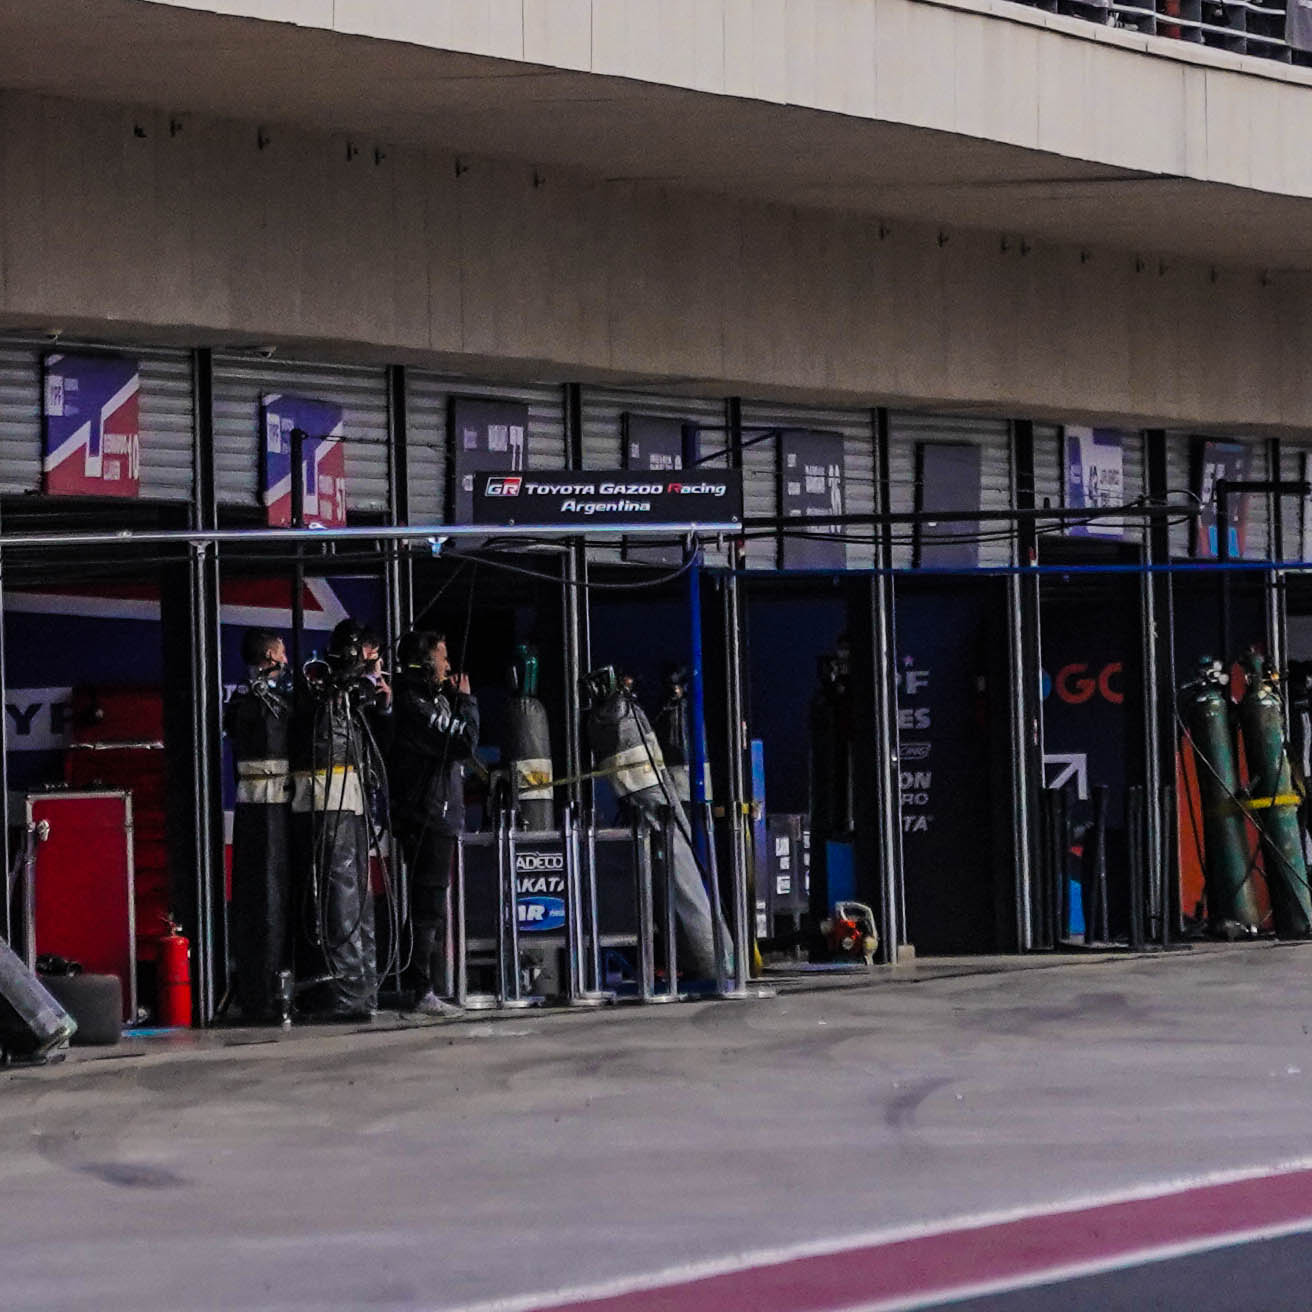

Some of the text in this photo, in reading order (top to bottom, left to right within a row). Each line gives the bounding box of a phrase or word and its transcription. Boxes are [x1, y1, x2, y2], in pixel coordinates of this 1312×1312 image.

[486, 481, 727, 497] GR TOYOTA GAZOO Racing
[560, 499, 651, 515] Argentina
